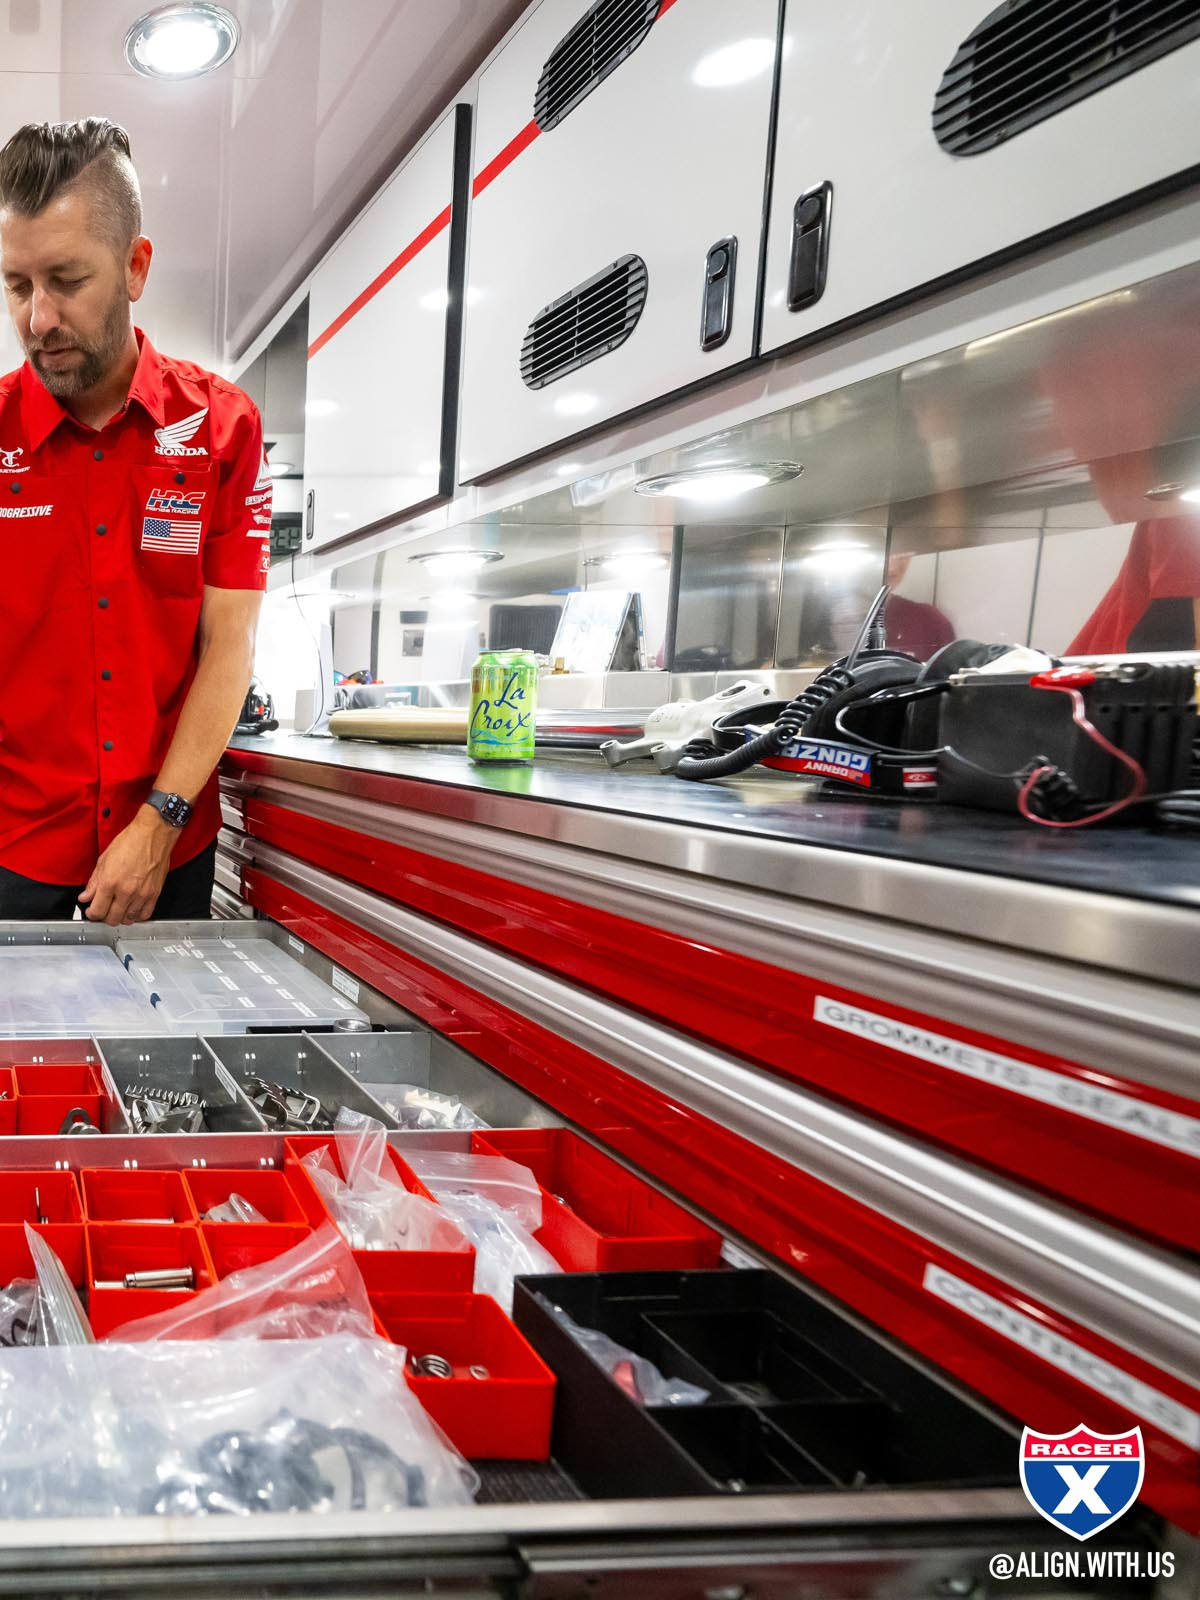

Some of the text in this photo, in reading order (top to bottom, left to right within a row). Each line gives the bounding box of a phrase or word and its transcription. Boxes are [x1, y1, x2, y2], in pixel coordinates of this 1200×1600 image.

[154, 446, 208, 456] HONDA
[147, 488, 206, 510] HRC
[494, 672, 525, 709] La
[470, 700, 531, 738] Croix
